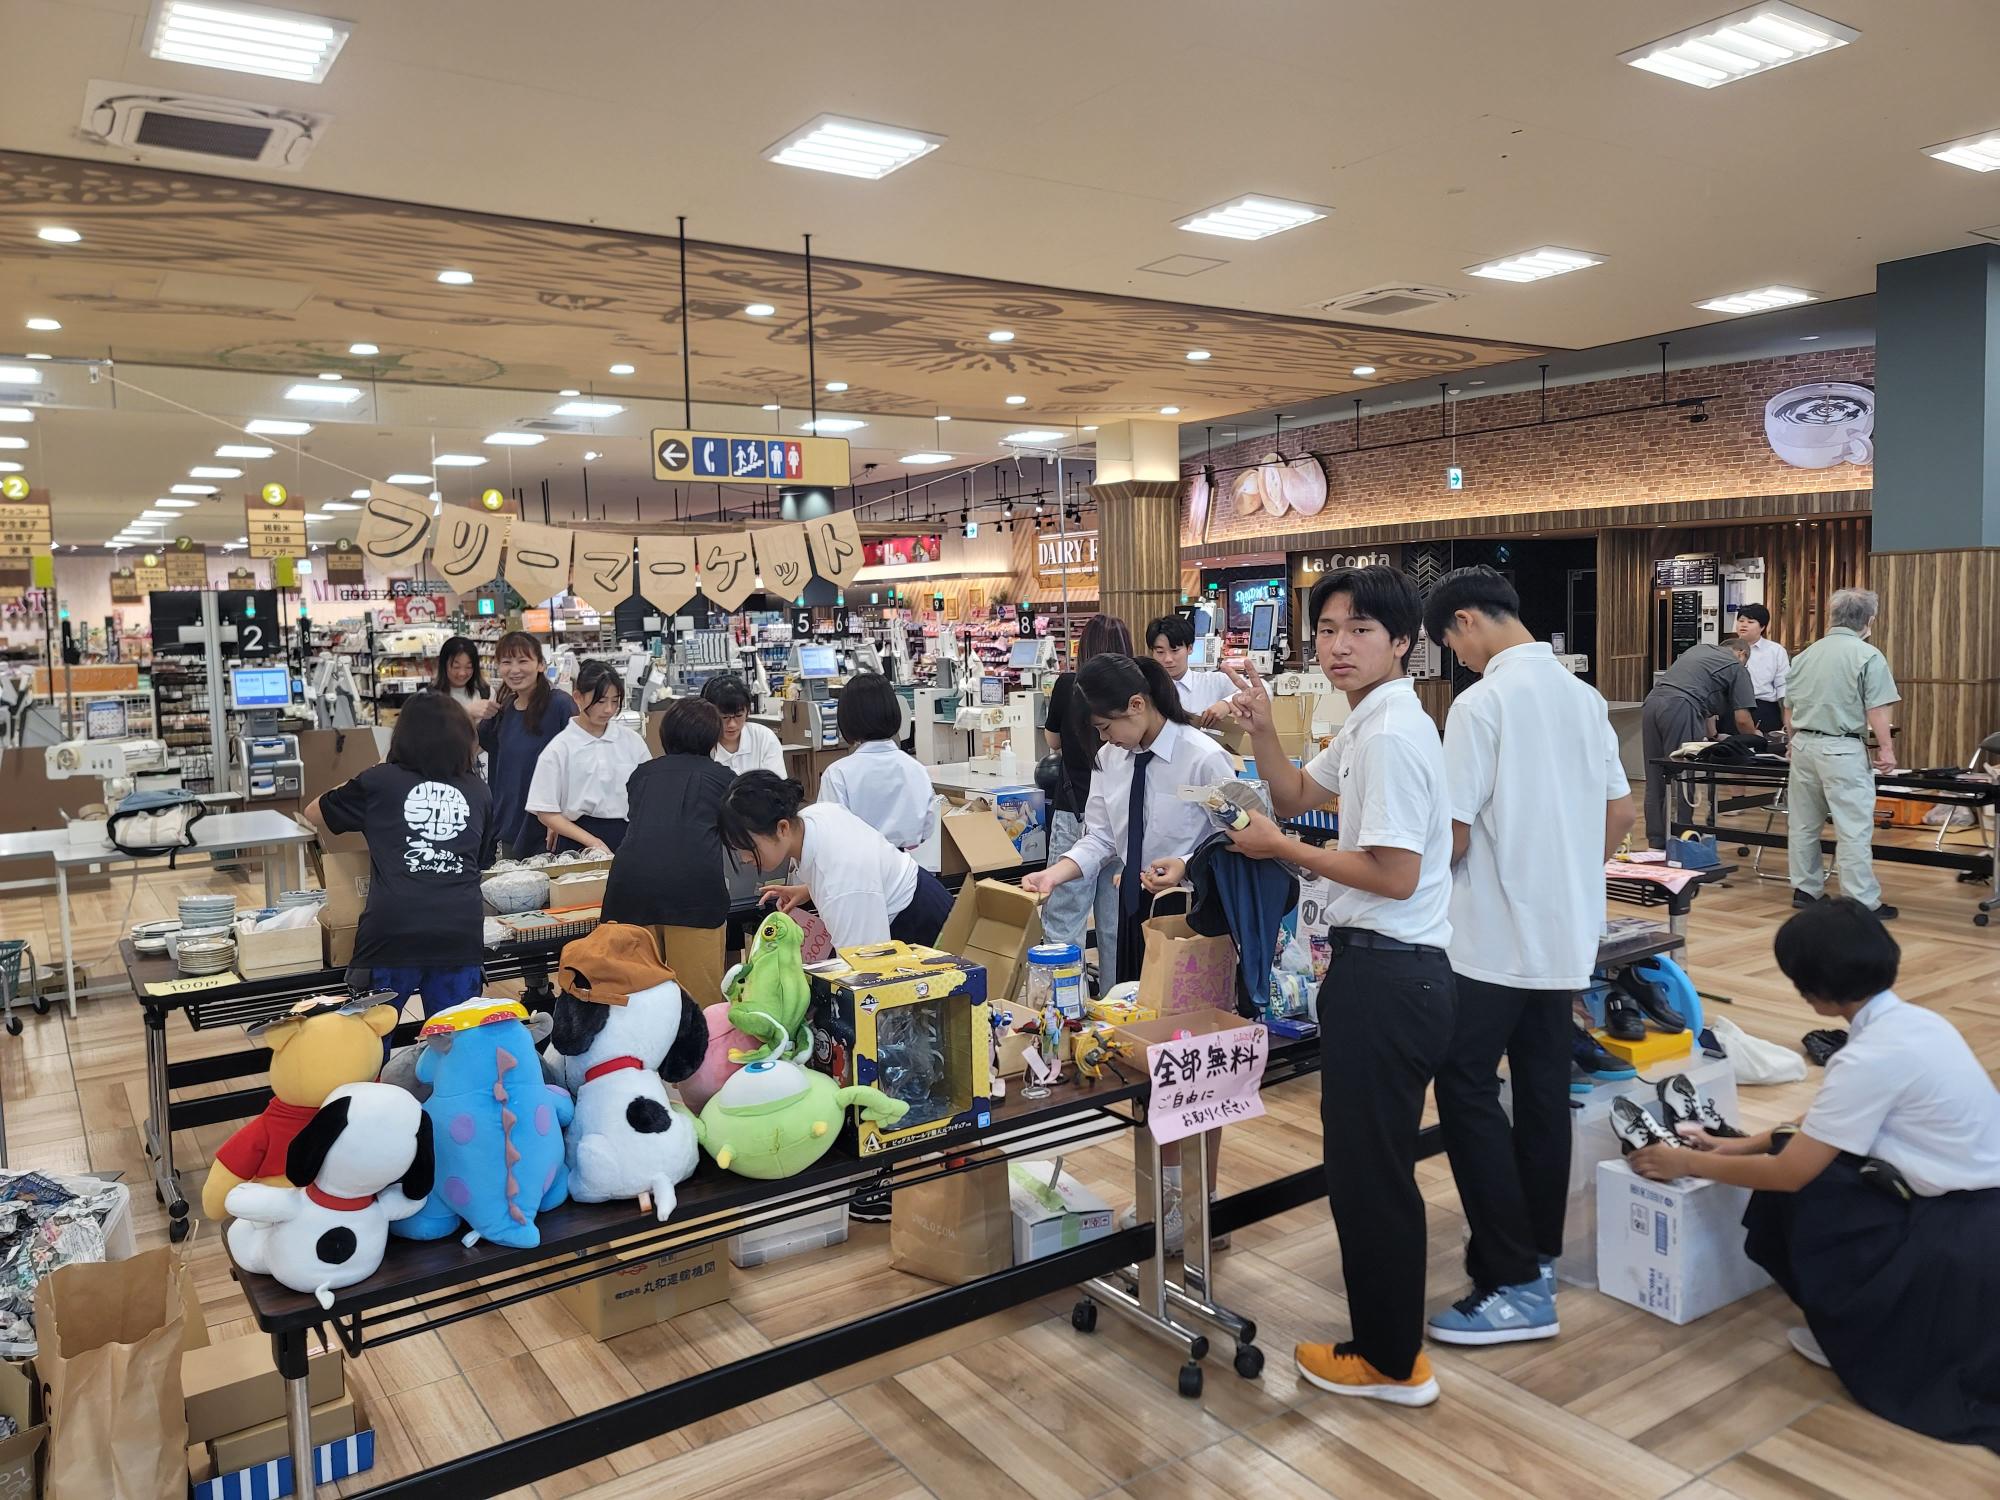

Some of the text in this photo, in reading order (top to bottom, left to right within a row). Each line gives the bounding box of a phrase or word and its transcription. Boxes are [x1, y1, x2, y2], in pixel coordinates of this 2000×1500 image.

[8, 479, 24, 497] 2
[269, 485, 281, 503] 3
[487, 491, 499, 507] 4
[340, 540, 347, 550] 8
[368, 498, 854, 593] フリーマーケット
[1038, 539, 1084, 565] DAIRY
[1208, 590, 1215, 599] 12
[1269, 587, 1276, 596] 13
[934, 600, 939, 609] 9
[797, 613, 810, 633] 5
[836, 612, 843, 632] 6
[1021, 616, 1031, 634] 8
[243, 625, 264, 651] 2
[304, 631, 310, 644] 3
[407, 781, 467, 804] ULTRA
[404, 799, 470, 824] STAFF
[1154, 1043, 1259, 1088] 全部無料
[1158, 1089, 1215, 1109] ご自由に
[1182, 1099, 1250, 1128] お取りください
